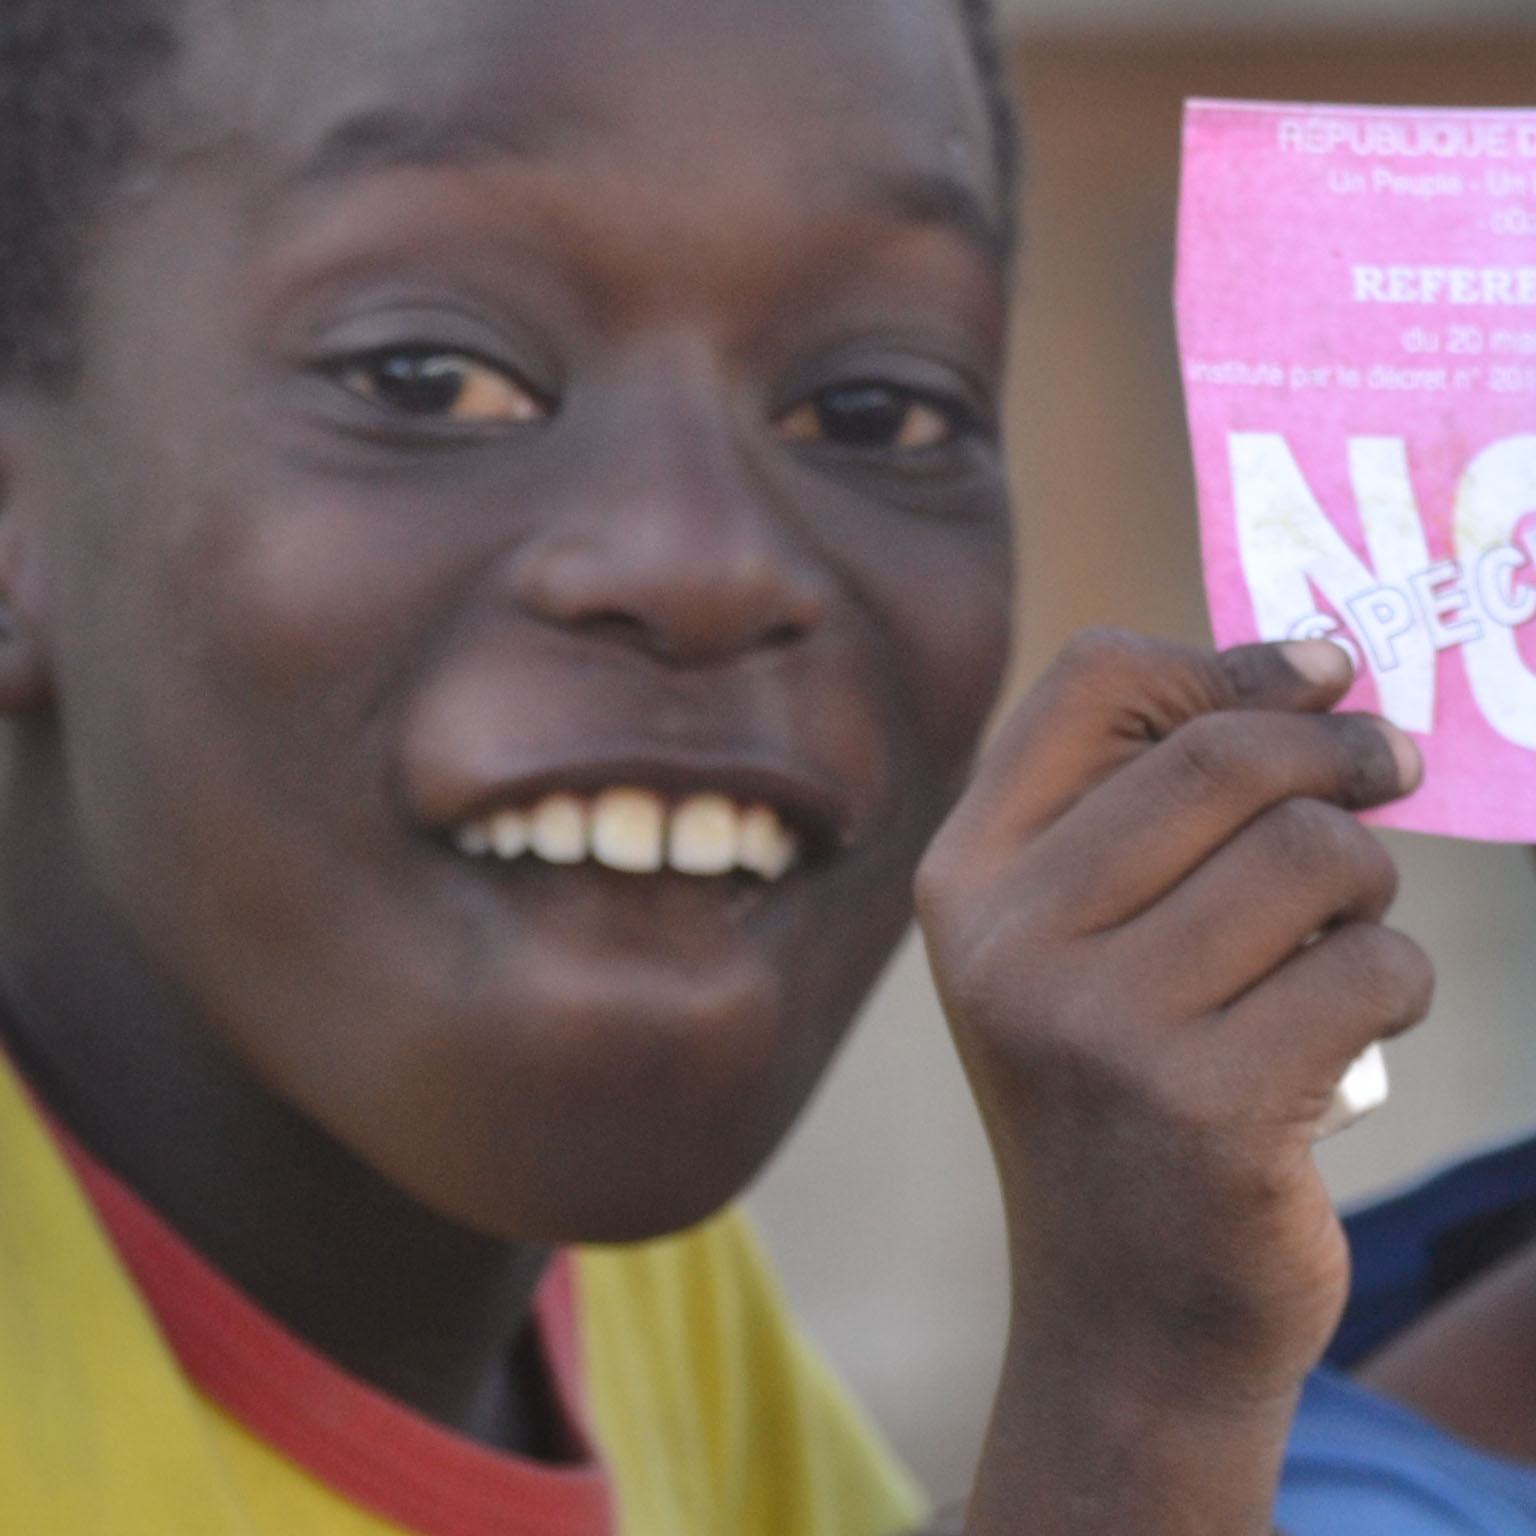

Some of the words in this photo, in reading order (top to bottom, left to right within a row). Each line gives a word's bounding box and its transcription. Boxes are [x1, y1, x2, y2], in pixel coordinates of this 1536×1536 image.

[1329, 167, 1364, 194] Un
[1372, 167, 1462, 199] Peuple
[1485, 170, 1525, 196] Un
[1402, 326, 1439, 353] du
[1447, 325, 1483, 354] 20
[1291, 367, 1332, 391] par
